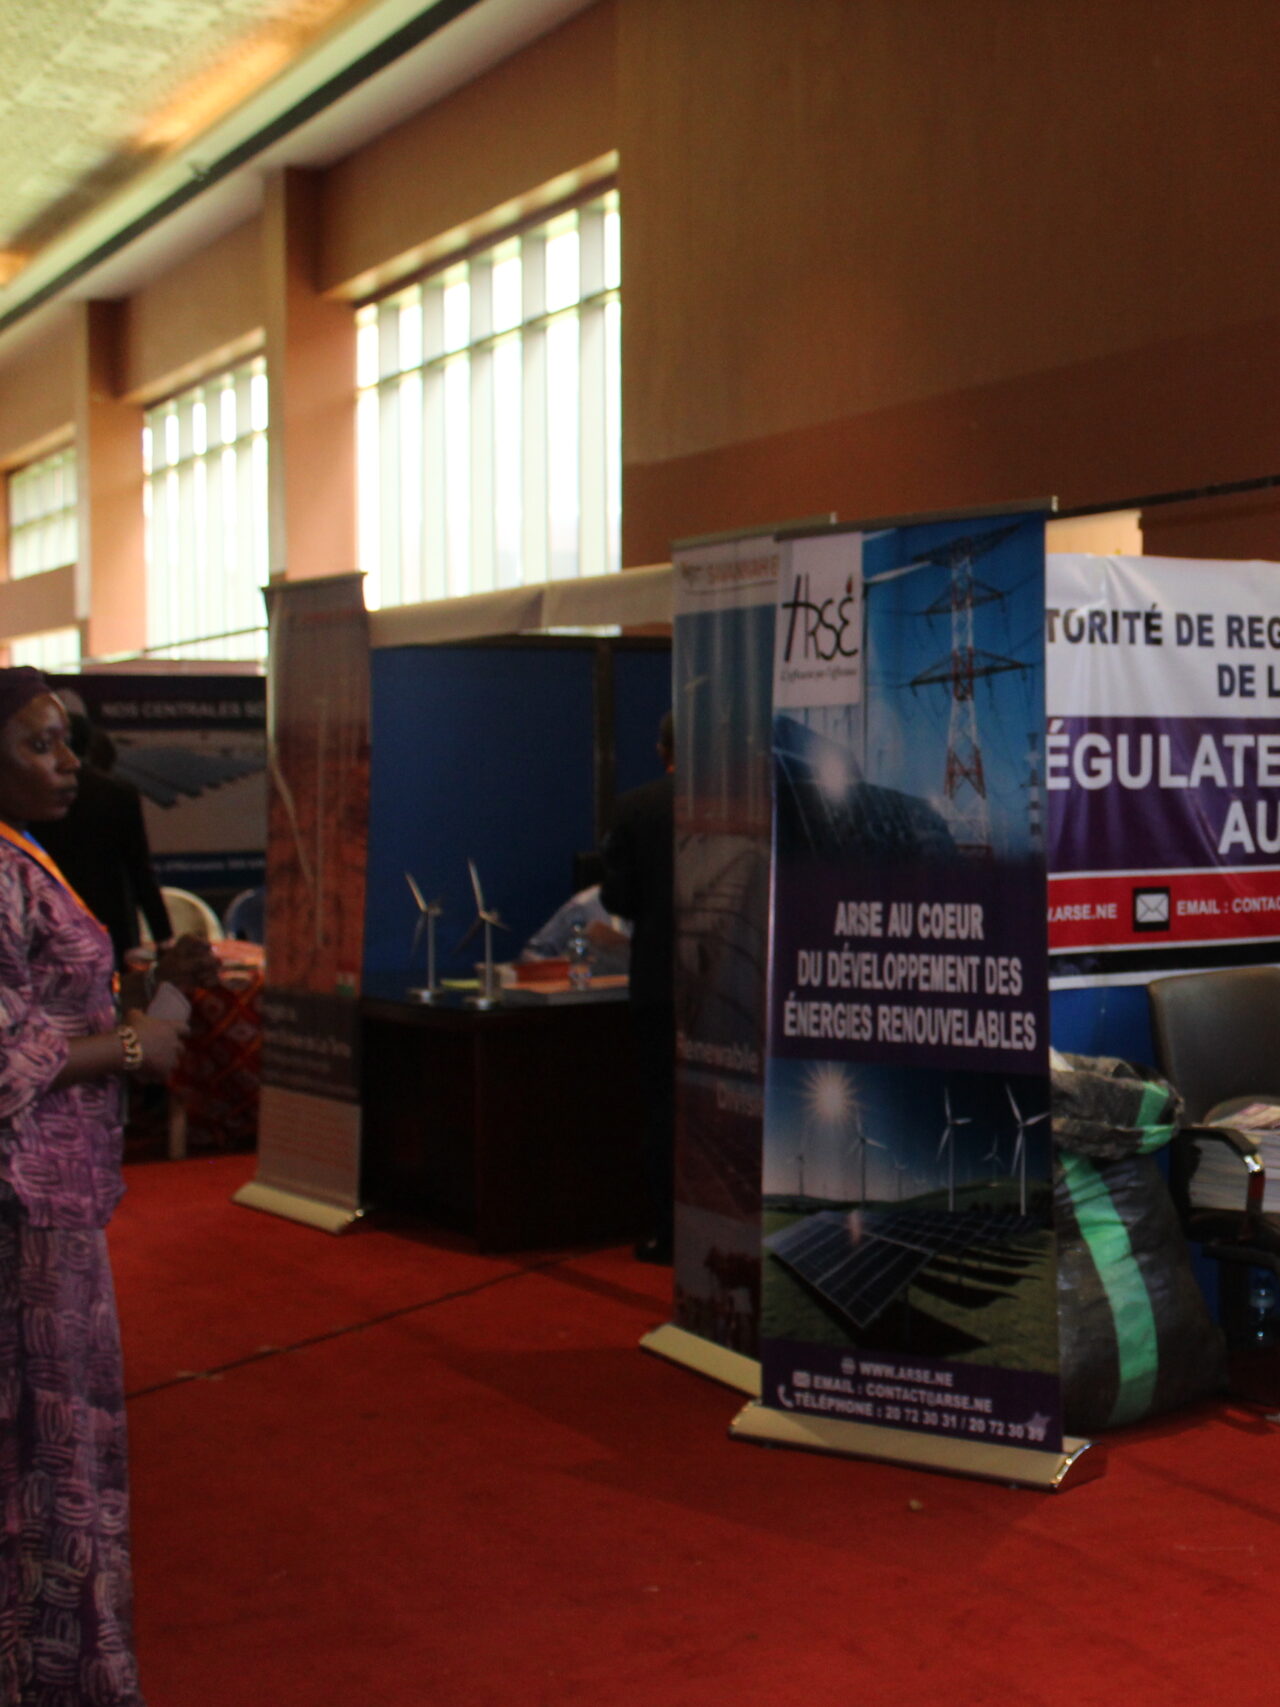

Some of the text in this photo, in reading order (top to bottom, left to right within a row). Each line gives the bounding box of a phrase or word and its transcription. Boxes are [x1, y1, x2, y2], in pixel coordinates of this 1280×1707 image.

[1176, 613, 1214, 647] DE
[1218, 664, 1255, 698] DE
[834, 901, 985, 940] ARSE AU COEUR
[1177, 899, 1220, 915] EMAIL
[797, 942, 1023, 996] DU DÉVELOPPEMENT DES
[784, 991, 1036, 1050] ÉNERGIES RENOUVELABLES
[813, 1374, 855, 1395] EMAIL
